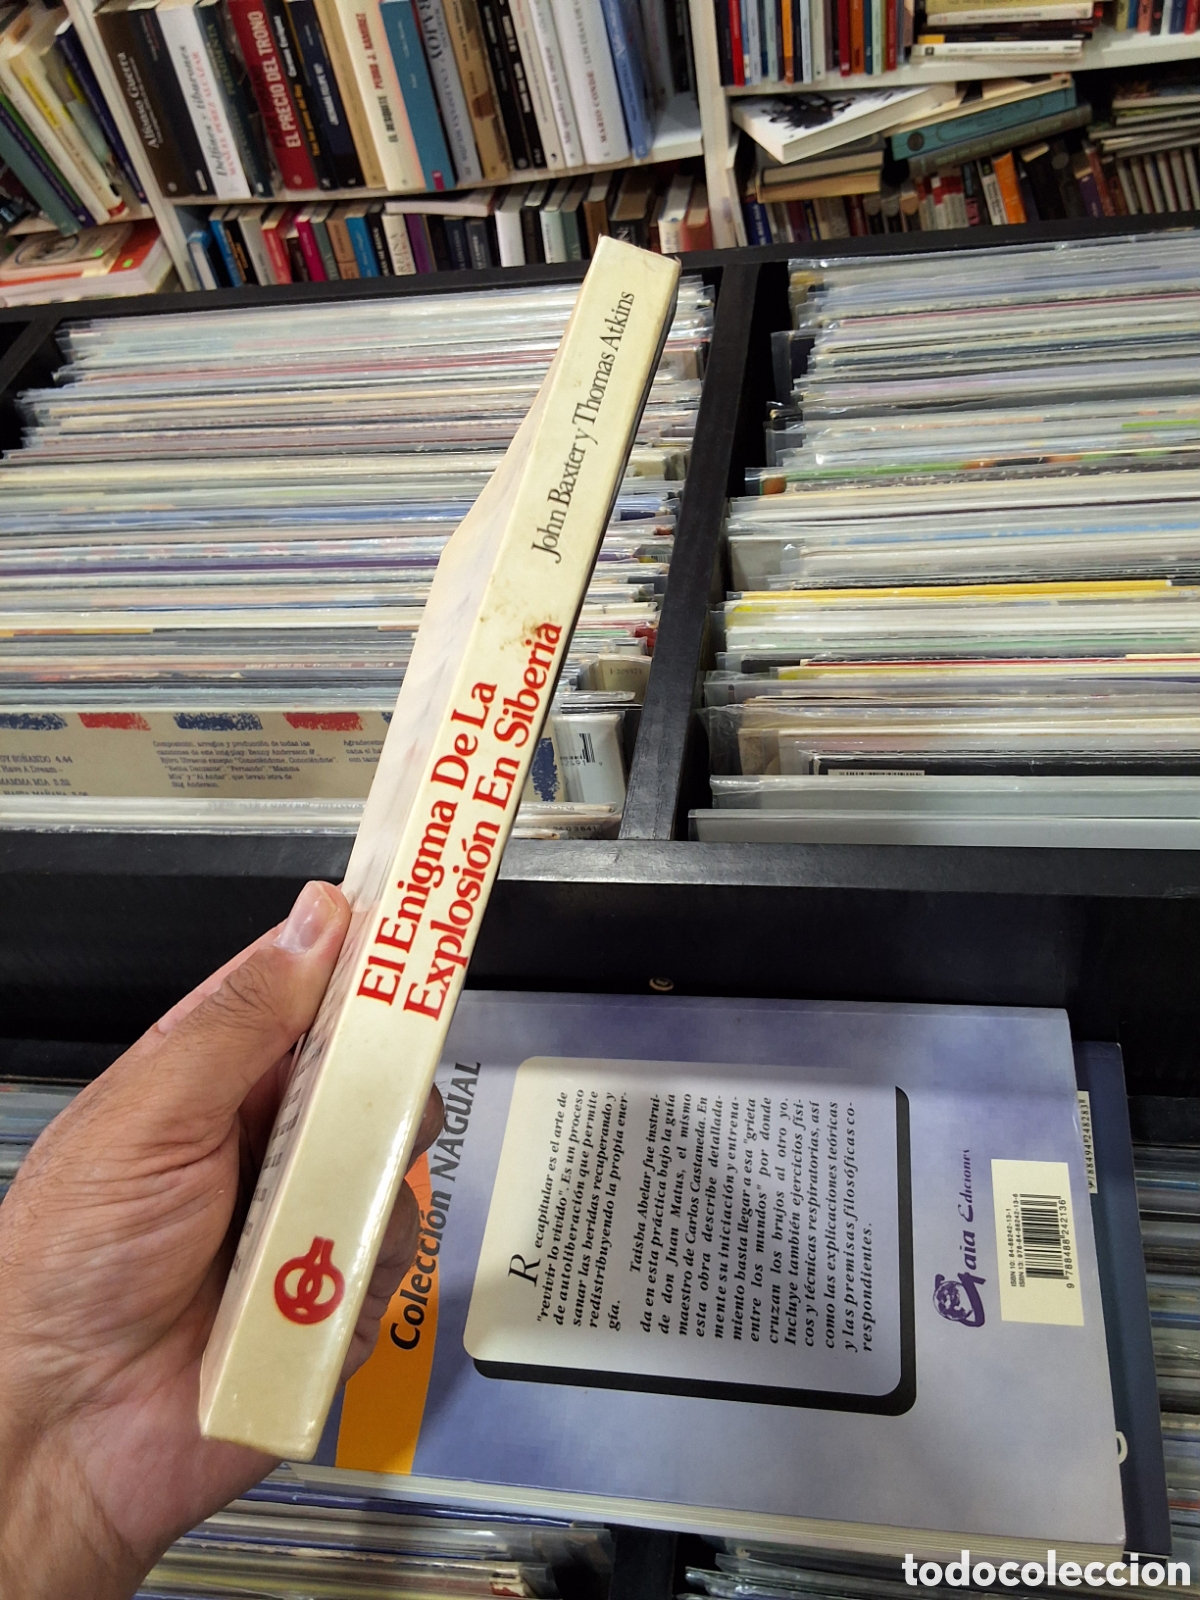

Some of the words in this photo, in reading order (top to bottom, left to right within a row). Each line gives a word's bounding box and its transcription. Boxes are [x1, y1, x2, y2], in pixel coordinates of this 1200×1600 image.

[247, 10, 273, 56] TRONO
[418, 0, 443, 60] RAJOY
[116, 51, 141, 98] Guerra
[178, 44, 205, 110] tiburones
[262, 57, 281, 81] DEL
[586, 70, 601, 108] CONDE
[133, 99, 160, 149] Alfonso
[268, 83, 297, 131] PRECIO
[593, 109, 608, 143] MARIO
[204, 124, 228, 177] Delfines
[286, 132, 301, 148] EL
[599, 291, 636, 351] Atkins
[573, 352, 615, 427] Thomas
[548, 451, 584, 509] Baxter
[532, 508, 568, 564] John
[452, 681, 498, 730] La
[493, 622, 563, 748] Siberia
[431, 733, 479, 790] De
[473, 760, 520, 811] En
[375, 799, 458, 953] Enigma
[403, 820, 501, 1021] Explosión
[356, 956, 406, 1006] El
[556, 1091, 568, 1108] de
[568, 1089, 584, 1144] proceso
[581, 1090, 598, 1150] permite
[617, 1092, 629, 1128] ener-
[645, 1094, 661, 1144] instrui-
[664, 1094, 677, 1127] guía
[678, 1093, 692, 1138] mismo
[696, 1096, 708, 1114] En
[758, 1096, 772, 1141] donde
[779, 1098, 792, 1121] yo.
[792, 1098, 807, 1132] físi-
[808, 1100, 820, 1124] así
[846, 1102, 856, 1126] co-
[549, 1140, 560, 1154] el
[554, 1110, 565, 1138] arte
[592, 1102, 613, 1191] recuperando
[660, 1128, 673, 1143] la
[707, 1095, 724, 1168] detallada-
[727, 1096, 740, 1160] entrena-
[776, 1126, 787, 1158] otro
[826, 1101, 838, 1161] teóricas
[548, 1156, 558, 1172] es
[560, 1167, 572, 1184] Es
[566, 1146, 576, 1164] un
[578, 1150, 591, 1178] que
[608, 1129, 626, 1182] propia
[642, 1145, 657, 1173] fue
[656, 1144, 673, 1178] bajo
[675, 1145, 688, 1160] el
[689, 1117, 706, 1194] Castaneda.
[744, 1149, 754, 1174] esa
[758, 1148, 772, 1178] por
[774, 1166, 786, 1182] al
[790, 1132, 805, 1207] ejercicios
[842, 1128, 859, 1222] filosóficas
[604, 1182, 618, 1198] la
[636, 1170, 652, 1220] Abelar
[669, 1168, 687, 1218] Matus,
[806, 1127, 822, 1231] respiratorias,
[390, 1190, 452, 1350] Colección
[430, 1061, 482, 1182] NAGUAL
[650, 1180, 668, 1249] práctica
[684, 1196, 700, 1245] Carlos
[700, 1176, 718, 1243] describe
[717, 1174, 735, 1259] iniciación
[736, 1188, 754, 1234] llegar
[770, 1190, 788, 1241] brujos
[824, 1164, 840, 1272] explicaciones
[1012, 1193, 1023, 1258] 978-84-88242-13-6
[546, 1245, 560, 1261] lo
[559, 1180, 586, 1302] autoliberación
[664, 1226, 680, 1268] Juan
[787, 1211, 801, 1277] también
[1006, 1208, 1014, 1258] 84-88242-13-1
[577, 1253, 592, 1277] las
[588, 1199, 615, 1329] redistribuyendo
[647, 1249, 660, 1285] esta
[682, 1247, 696, 1268] de
[697, 1252, 712, 1292] obra
[718, 1262, 729, 1283] su
[750, 1262, 764, 1288] los
[769, 1250, 783, 1275] los
[803, 1234, 817, 1301] técnicas
[842, 1221, 859, 1308] premisas
[572, 1278, 588, 1328] sanar
[644, 1286, 656, 1308] en
[660, 1272, 676, 1304] don
[678, 1269, 694, 1336] maestro
[822, 1274, 836, 1300] las
[859, 1222, 877, 1352] respondientes.
[552, 1304, 566, 1326] de
[607, 1299, 622, 1332] gía.
[639, 1310, 653, 1334] da
[657, 1313, 671, 1335] de
[695, 1301, 708, 1338] esta
[714, 1285, 728, 1340] mente
[730, 1284, 746, 1341] miento
[749, 1296, 762, 1343] entre
[769, 1283, 782, 1345] cruzan
[784, 1281, 802, 1346] Incluye
[804, 1317, 816, 1348] cos
[824, 1302, 836, 1350] como
[841, 1308, 855, 1337] las
